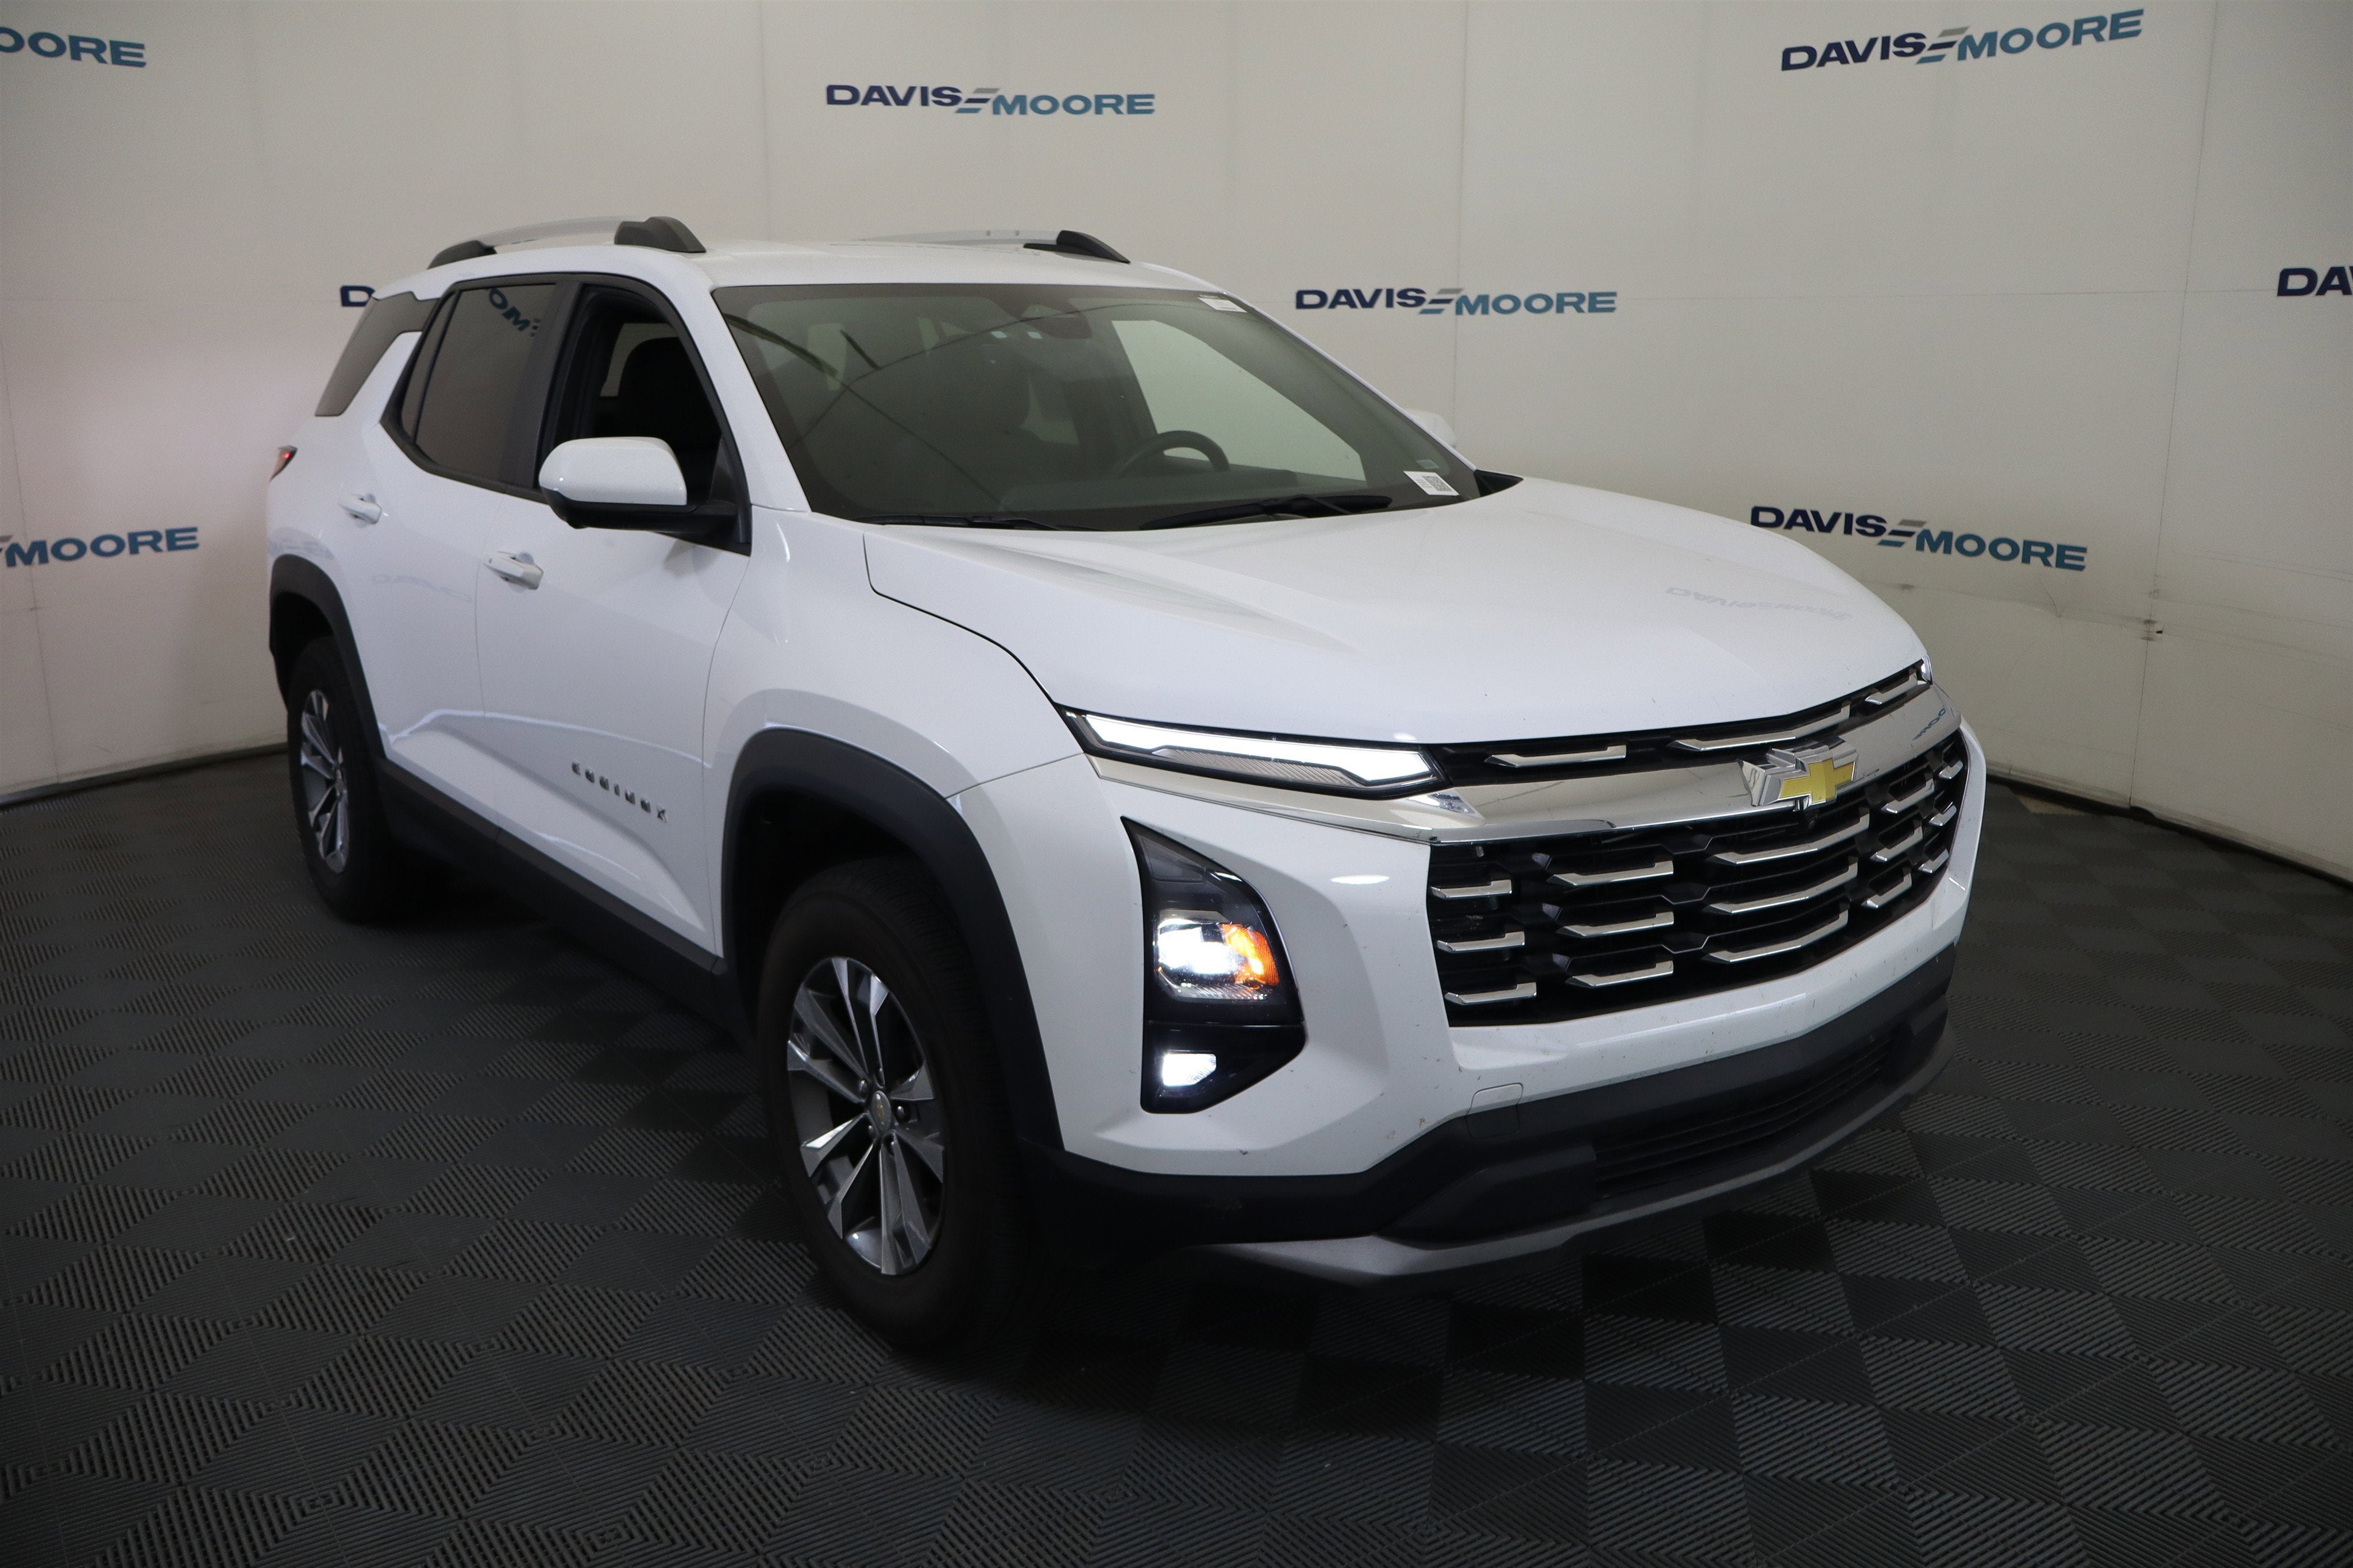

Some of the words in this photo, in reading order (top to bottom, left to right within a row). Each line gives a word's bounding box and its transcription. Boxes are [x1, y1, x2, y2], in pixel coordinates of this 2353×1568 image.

[1781, 32, 1927, 72] DAVIS
[1957, 8, 2144, 61] MOORE
[826, 84, 963, 107] DAVIS
[992, 94, 1155, 115] MOORE
[2277, 265, 2353, 297] DA
[1295, 287, 1427, 310] DAVIS
[1455, 291, 1618, 316] MOORE
[4, 527, 199, 568] MOORE
[1750, 505, 1887, 538] DAVIS
[1915, 528, 2088, 572] MOORE
